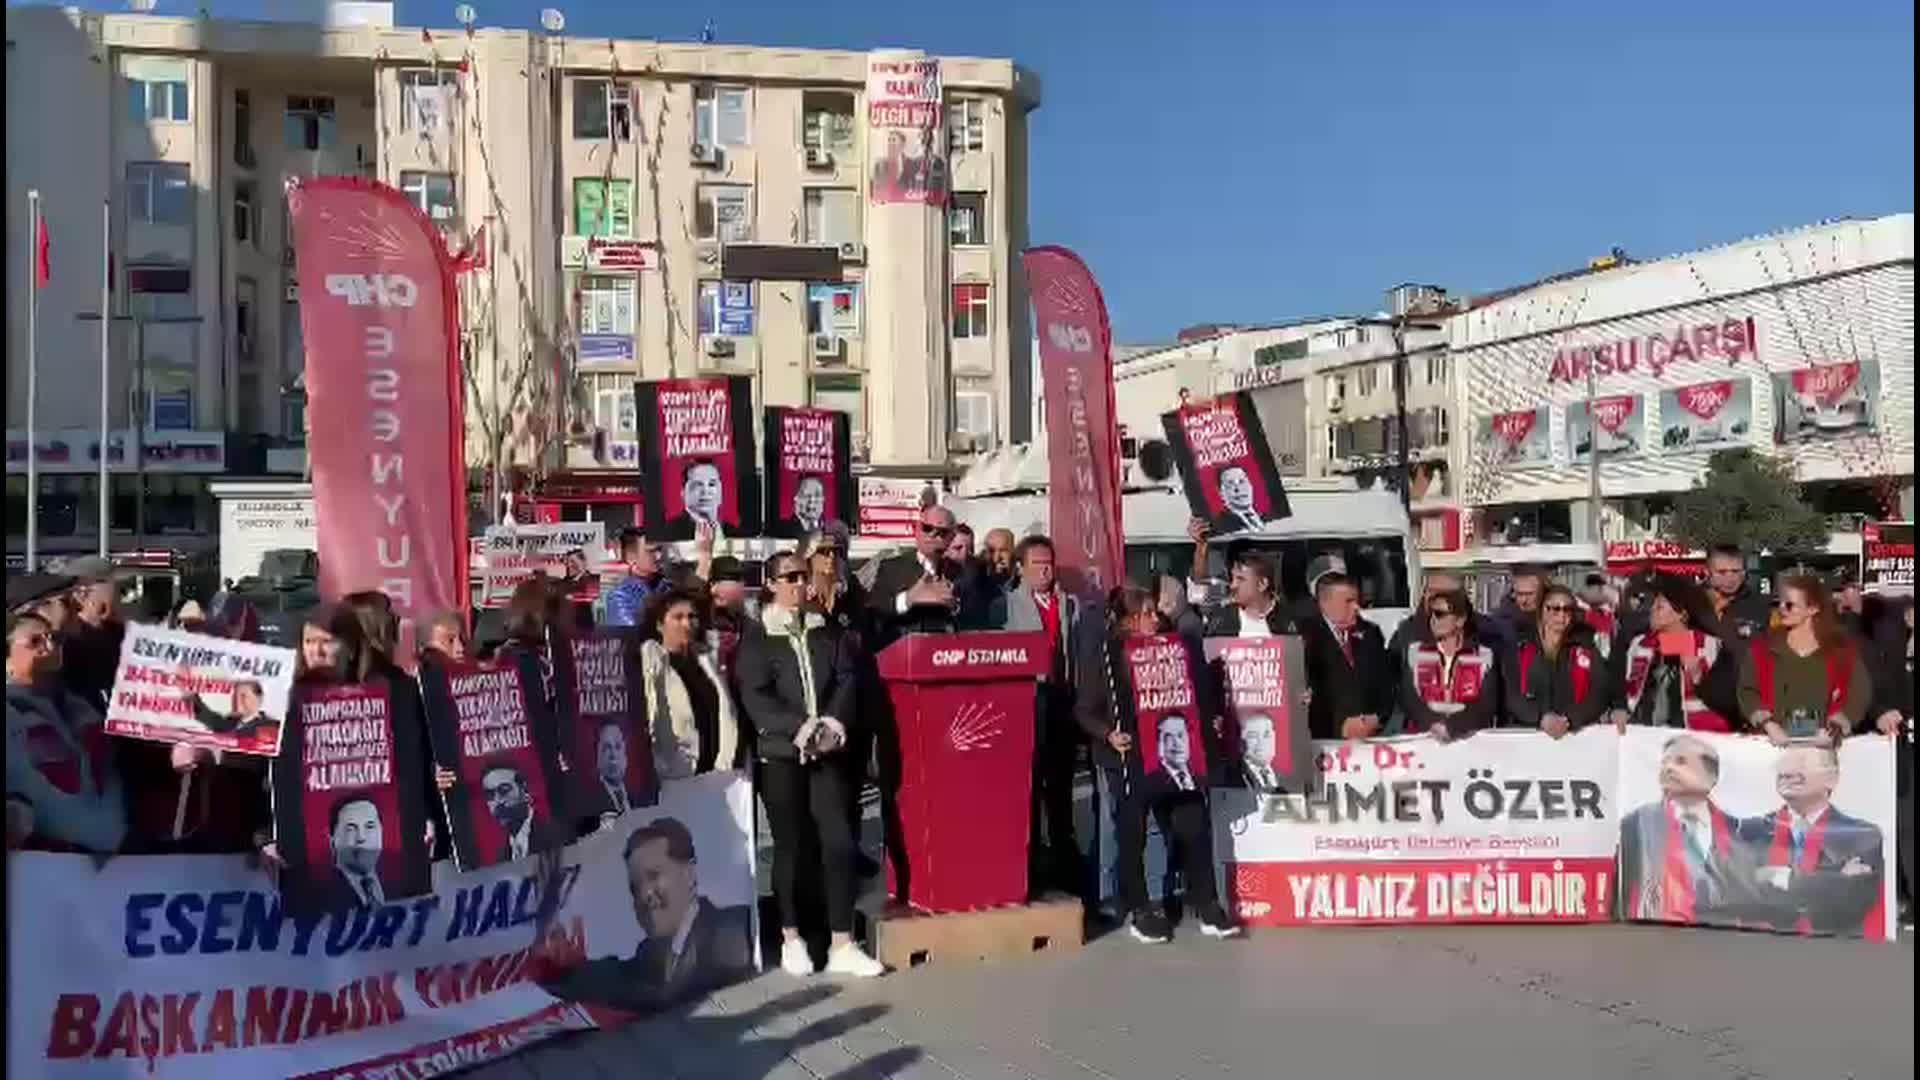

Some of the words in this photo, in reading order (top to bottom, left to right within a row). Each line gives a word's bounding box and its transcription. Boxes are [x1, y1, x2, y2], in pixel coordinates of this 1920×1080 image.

[1648, 316, 1758, 378] ÇARŞI
[932, 649, 965, 666] CHP
[1315, 743, 1361, 773] of.
[1374, 743, 1425, 770] Dr.
[1262, 778, 1450, 825] AHMET
[1464, 769, 1605, 821] ÖZER
[124, 889, 440, 958] ESENYURT
[445, 863, 581, 942] HAL
[1288, 873, 1418, 919] YALNIZ
[1426, 859, 1588, 918] DEĞİLDİR
[1596, 872, 1608, 915] !
